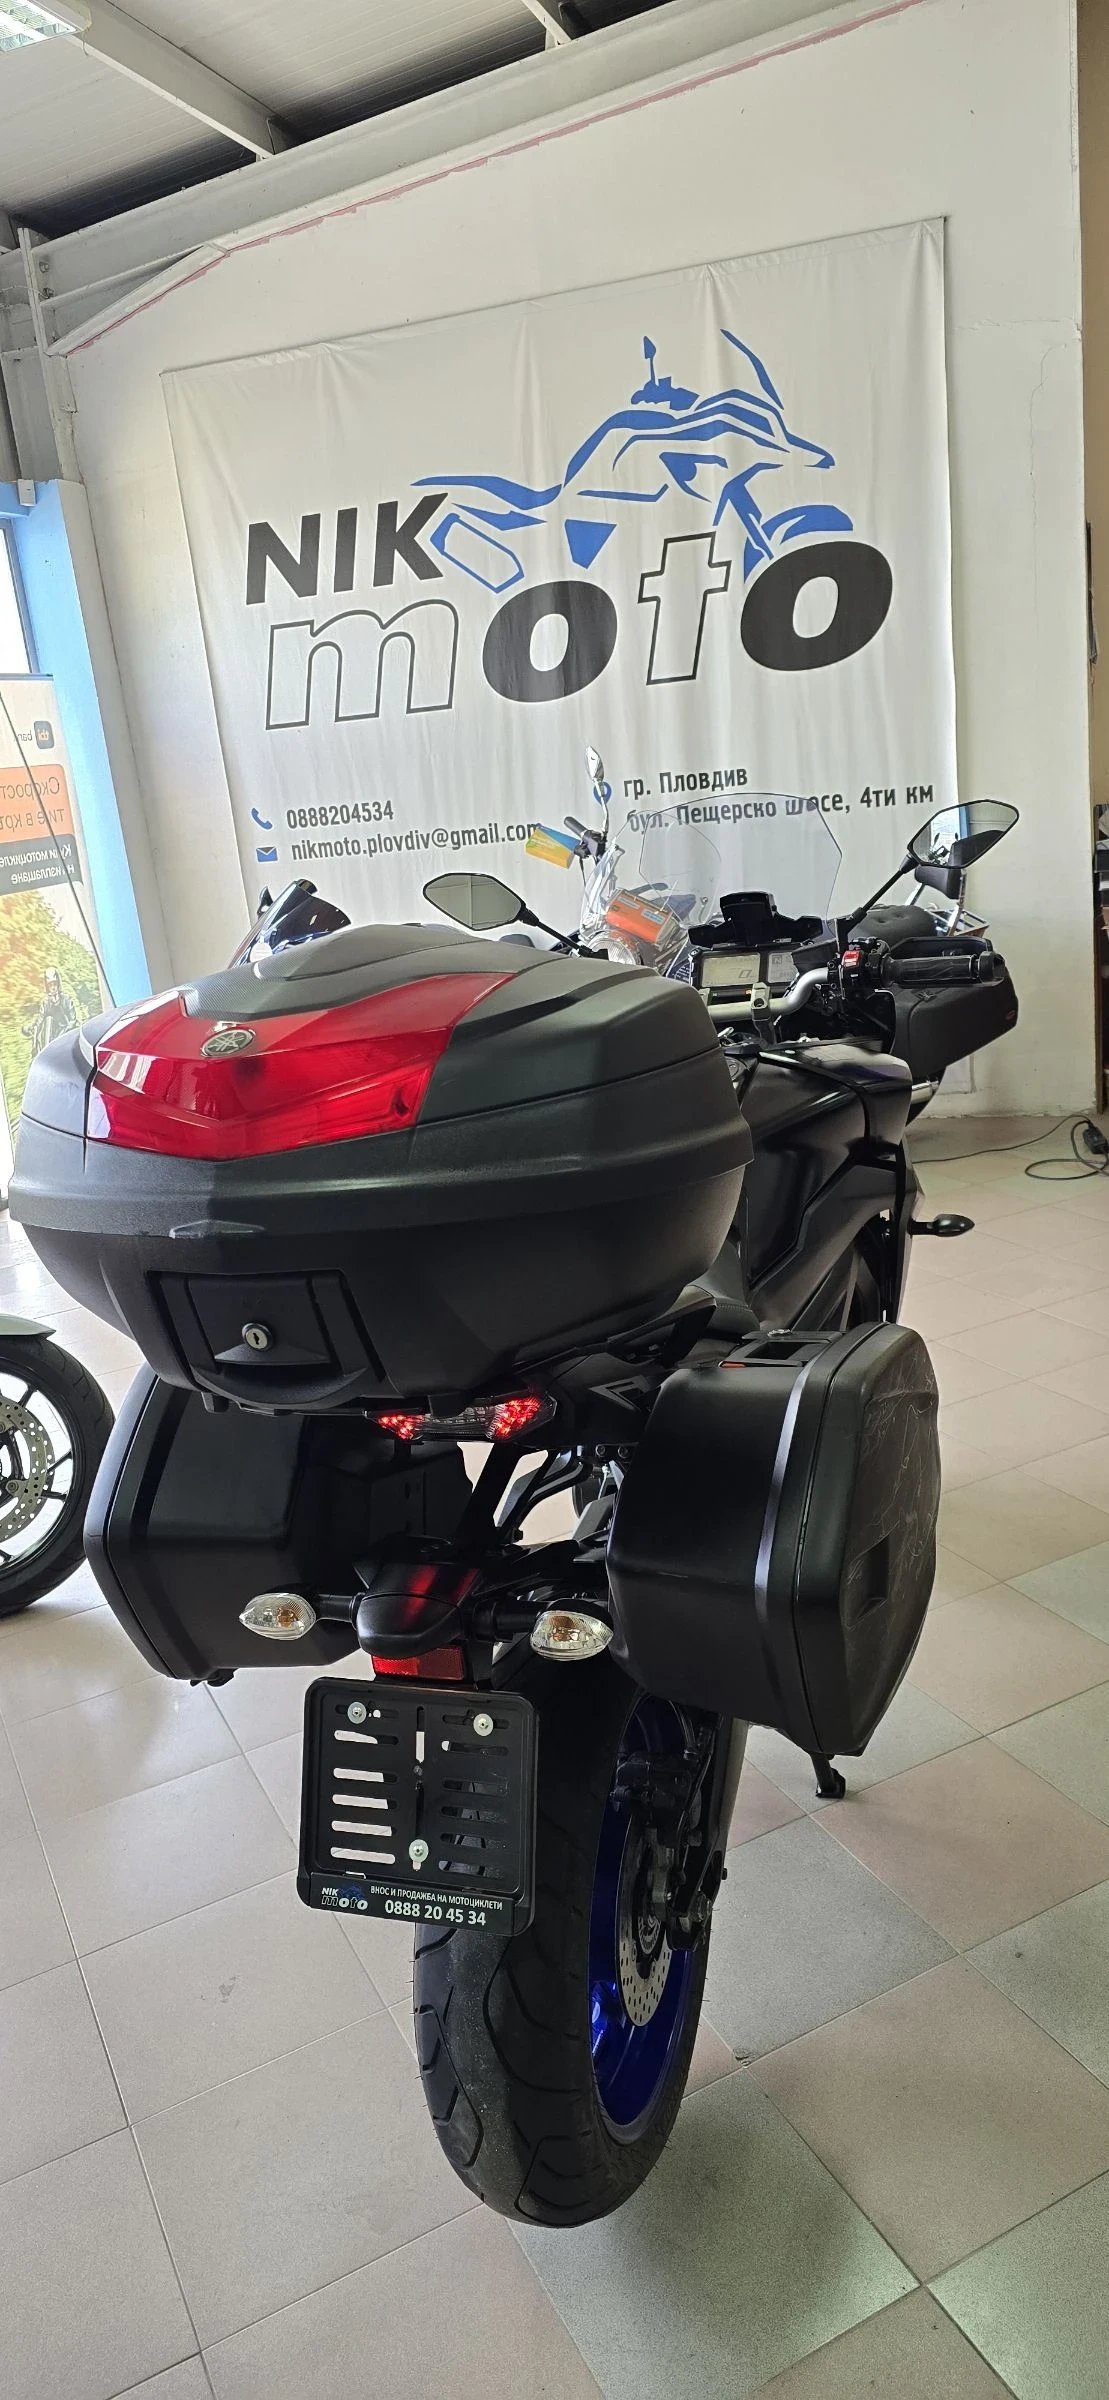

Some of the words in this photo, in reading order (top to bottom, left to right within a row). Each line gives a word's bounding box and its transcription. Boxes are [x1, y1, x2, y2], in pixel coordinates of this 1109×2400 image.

[246, 492, 448, 605] NIK
[265, 531, 893, 731] moto
[623, 778, 651, 800] гр.
[660, 767, 748, 795] Пловдив
[286, 800, 394, 830] 0888204534
[627, 809, 669, 835] бул.
[676, 798, 777, 827] Пещерско
[785, 793, 850, 814] шосе,
[860, 786, 896, 808] 4ти
[906, 784, 933, 804] км
[291, 823, 542, 860] nikmoto.plovdiv@gmail.com
[321, 1887, 339, 1896] NIK
[321, 1895, 368, 1911] moto
[370, 1885, 389, 1896] ВНОС
[389, 1888, 396, 1897] И
[397, 1889, 436, 1902] ПРОДАЖБА
[437, 1893, 448, 1903] НА
[448, 1895, 503, 1911] МОТОЦИКЛЕТИ
[385, 1900, 420, 1917] 0888
[424, 1904, 443, 1920] 20
[445, 1908, 464, 1923] 45
[467, 1911, 487, 1926] 34
